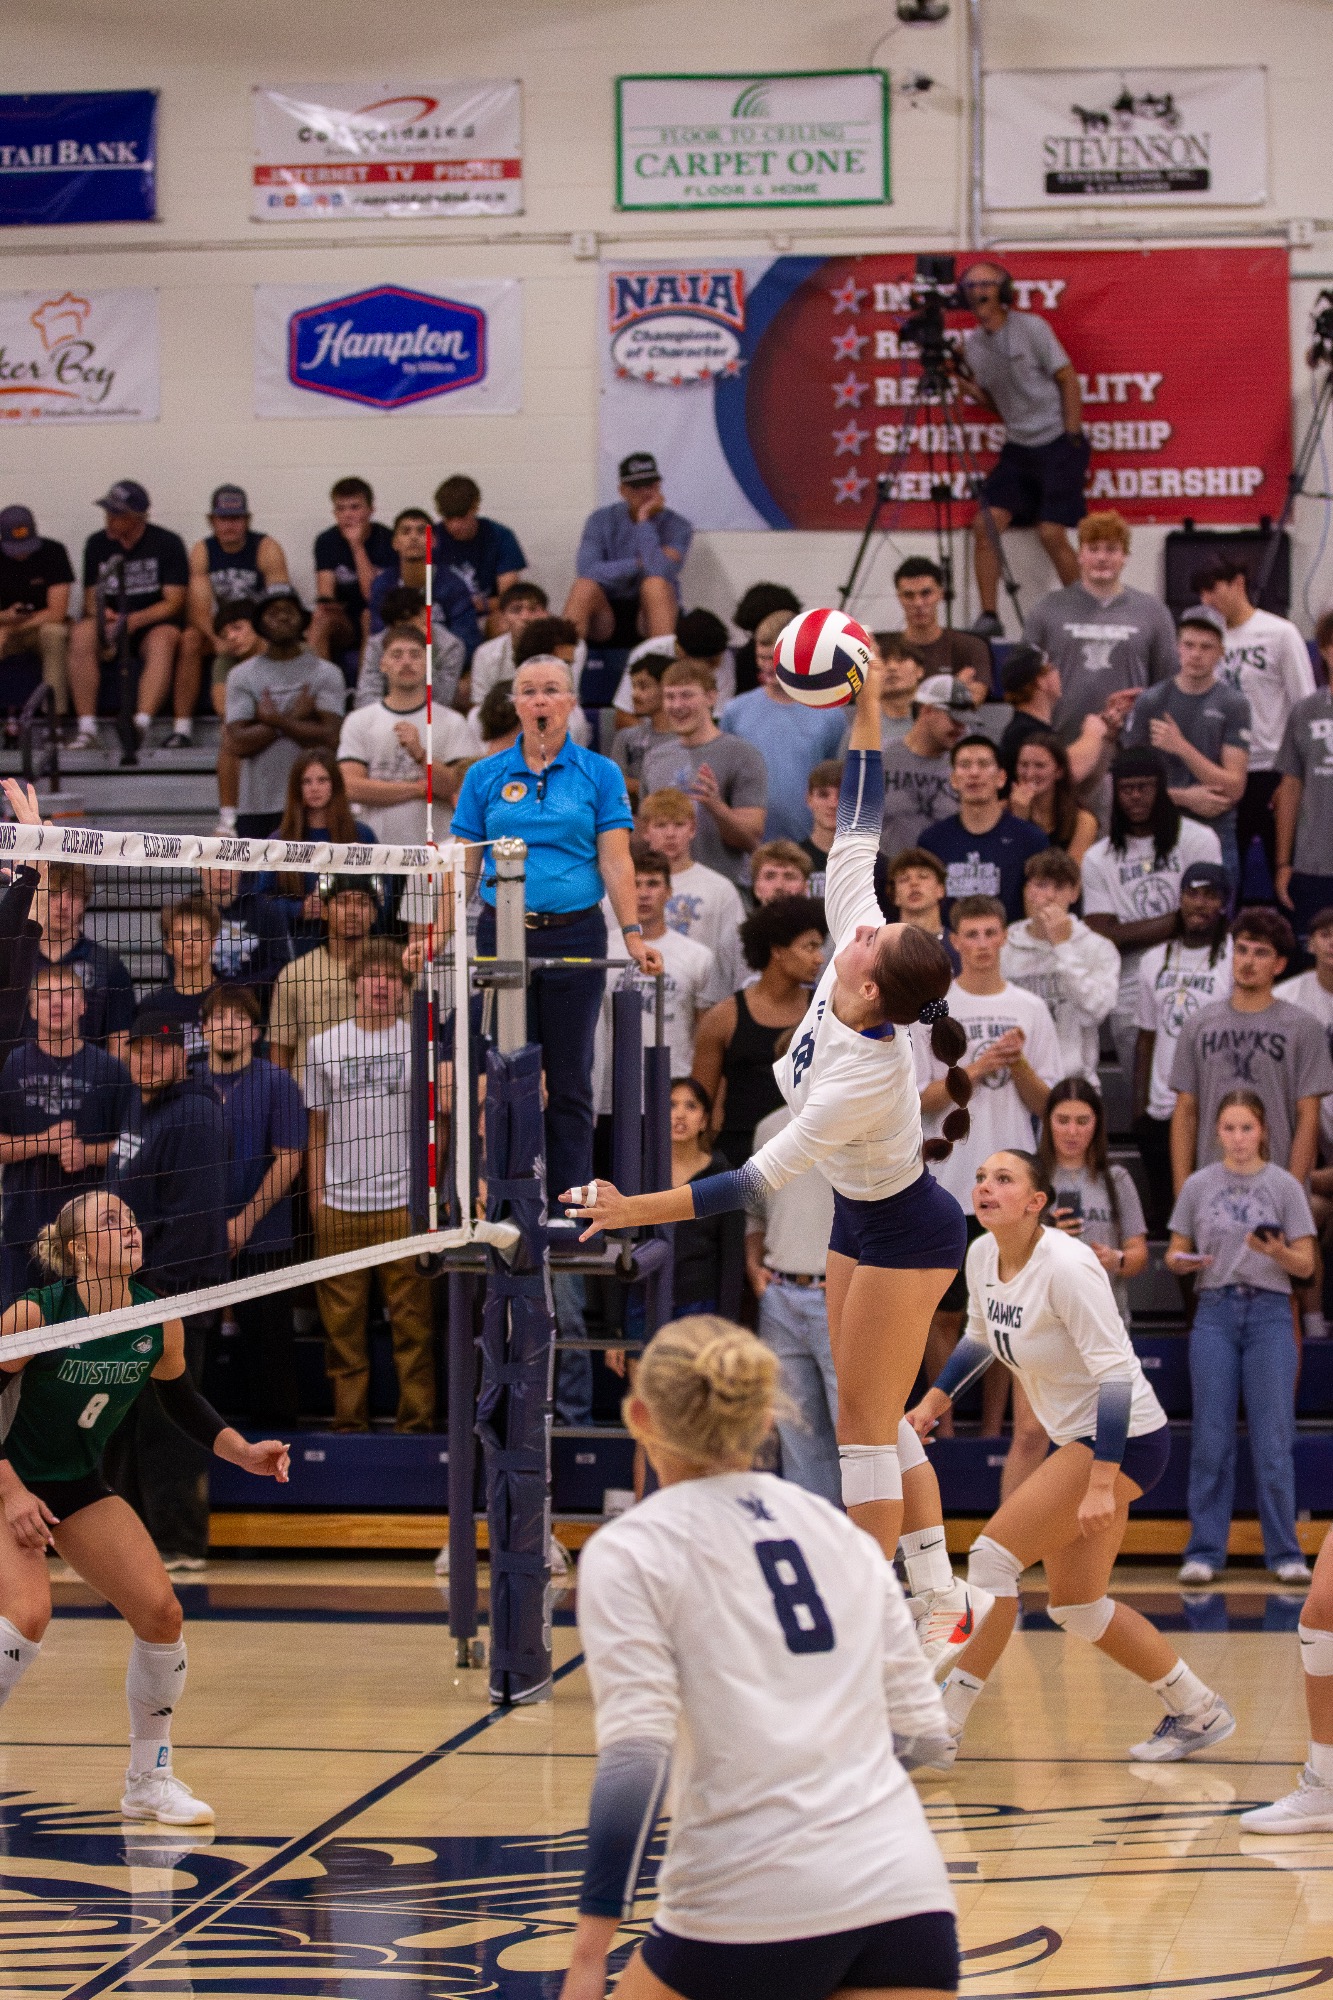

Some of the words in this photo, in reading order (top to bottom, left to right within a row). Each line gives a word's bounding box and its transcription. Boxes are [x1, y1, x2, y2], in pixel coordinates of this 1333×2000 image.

[730, 125, 757, 142] TO
[1043, 132, 1210, 168] STEVENSON
[57, 139, 138, 164] BANK
[634, 150, 779, 179] CARPET
[786, 148, 867, 176] ONE
[387, 163, 414, 181] TV
[615, 275, 738, 320] NAIA
[300, 319, 471, 371] Hampton
[49, 340, 116, 404] Boy
[1083, 466, 1264, 499] ADERSHIP
[61, 829, 80, 853] BLUE
[79, 831, 104, 856] HAWKS
[143, 835, 161, 857] BLUE
[160, 836, 182, 858] HAWKS
[1201, 1029, 1287, 1062] HAWKS
[987, 1298, 1024, 1329] HAWKS
[993, 1329, 1022, 1370] 11
[56, 1358, 150, 1385] MYSTICS
[77, 1392, 110, 1429] 8
[754, 1538, 836, 1656] 8
